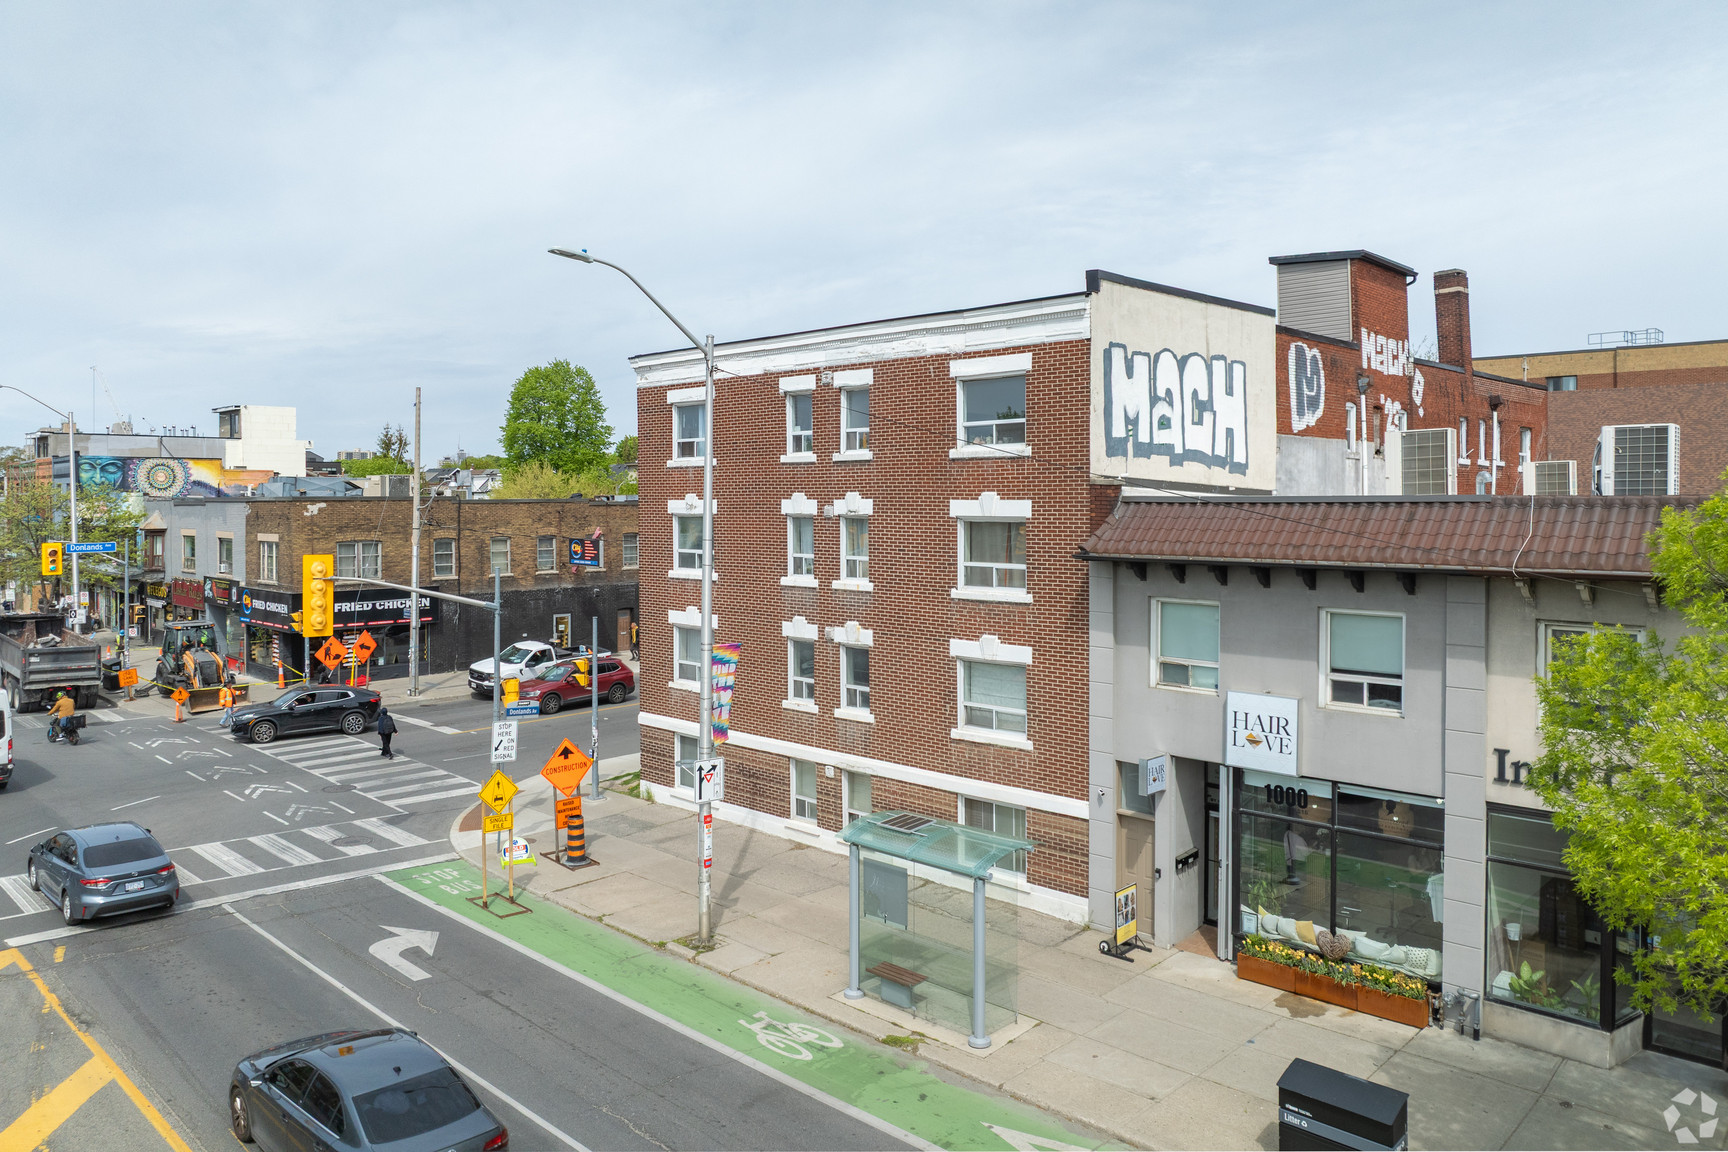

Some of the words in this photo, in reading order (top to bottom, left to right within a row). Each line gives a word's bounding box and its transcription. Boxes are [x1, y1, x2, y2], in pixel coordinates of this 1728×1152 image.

[252, 599, 265, 610] FRIED
[266, 602, 288, 613] CHICKEN
[334, 602, 373, 613] FRIED
[1232, 710, 1292, 737] HAIR
[545, 761, 588, 776] CONSTRUCTION
[1148, 764, 1165, 777] HAIR
[1264, 784, 1308, 809] 1000
[490, 815, 508, 823] SINGLE
[412, 868, 460, 884] STOP
[1284, 1112, 1301, 1126] Litter
